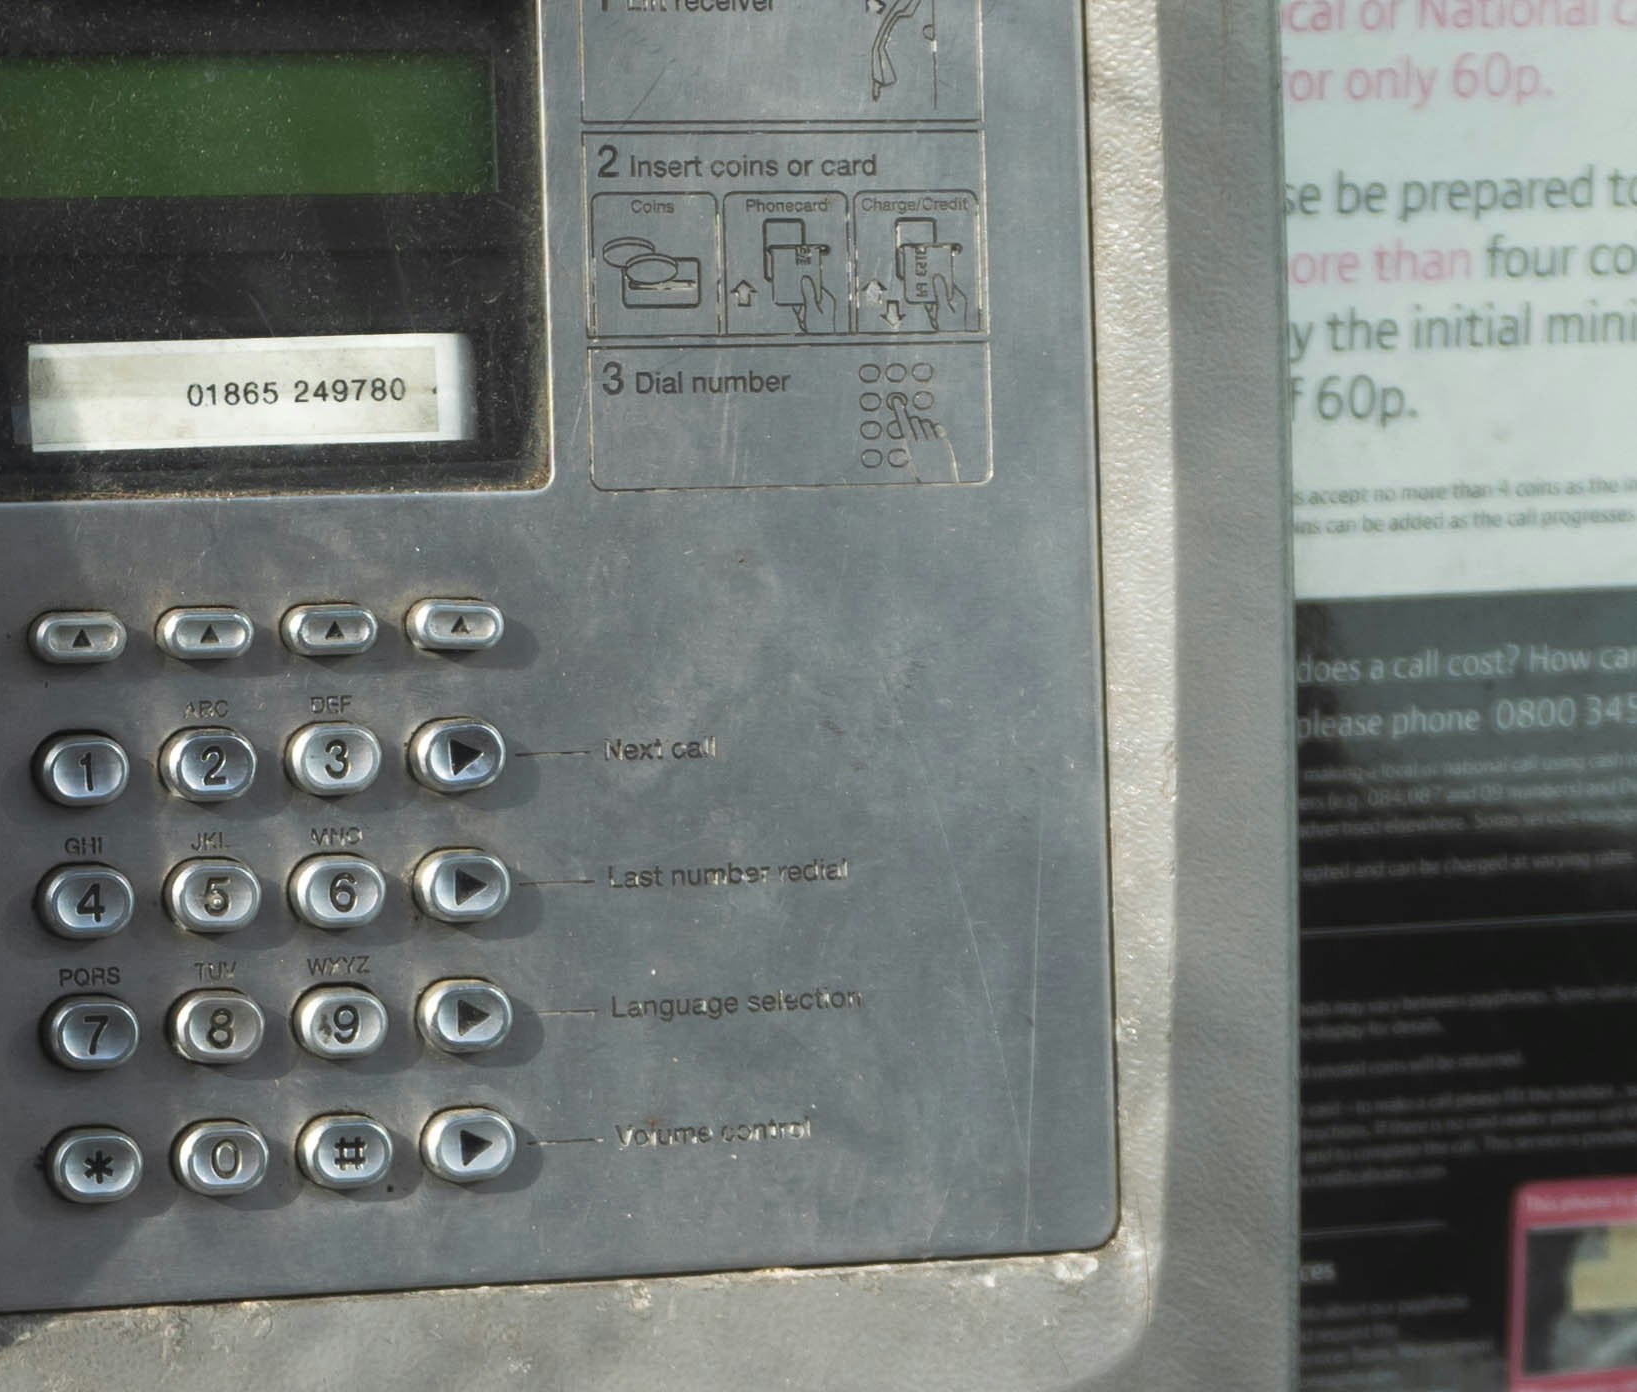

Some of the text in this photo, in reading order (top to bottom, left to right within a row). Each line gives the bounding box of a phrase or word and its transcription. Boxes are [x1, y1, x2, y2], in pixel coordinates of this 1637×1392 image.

[1346, 55, 1439, 111] only
[1452, 51, 1554, 106] 60p.
[597, 144, 878, 179] 2 Insert coins or card
[630, 198, 676, 215] Coins
[746, 196, 829, 214] Phonecard
[862, 196, 970, 215] Charge/Credit
[1336, 169, 1388, 215] be
[1400, 164, 1595, 222] prepared
[1287, 249, 1361, 286] ore
[1373, 239, 1473, 285] than
[1485, 233, 1578, 281] four
[1326, 306, 1400, 352] the
[1413, 301, 1532, 350] initial
[187, 377, 408, 407] 01865 249780
[602, 360, 792, 396] 3 Dial number
[1316, 373, 1418, 427] 60p.
[1309, 487, 1367, 508] accept
[1373, 487, 1397, 504] no
[1401, 485, 1447, 504] more
[1451, 478, 1492, 500] than
[1514, 477, 1561, 498] coins
[1565, 481, 1585, 496] as
[1588, 474, 1619, 495] the
[1326, 518, 1358, 535] can
[1363, 512, 1386, 533] be
[1389, 511, 1446, 532] added
[1449, 515, 1467, 530] as
[1472, 509, 1503, 529] the
[1507, 507, 1538, 528] call
[1297, 655, 1361, 684] does
[1370, 660, 1385, 681] a
[1393, 648, 1440, 680] call
[1448, 644, 1520, 678] cost?
[1529, 644, 1591, 674] How
[183, 700, 230, 719] ABC
[310, 696, 353, 714] DEF
[1297, 709, 1383, 742] please
[1392, 704, 1481, 741] phone
[1495, 696, 1576, 731] 0800
[201, 746, 227, 786] 2
[324, 739, 349, 779] 3
[603, 736, 716, 761] Next call
[78, 753, 96, 791] 1
[64, 837, 104, 856] GHI
[191, 831, 230, 852] JKL
[311, 827, 362, 847] MNO
[608, 858, 850, 889] Last number redial
[76, 883, 105, 923] 4
[203, 876, 231, 917] 5
[329, 872, 356, 913] 6
[59, 966, 121, 987] PQRS
[194, 961, 236, 981] TUV
[307, 955, 371, 976] WXYZ
[610, 987, 862, 1021] Language selection
[83, 1015, 109, 1055] 7
[207, 1008, 234, 1049] 8
[332, 1004, 359, 1044] 9
[615, 1117, 812, 1150] Volume control
[211, 1140, 242, 1179] 0
